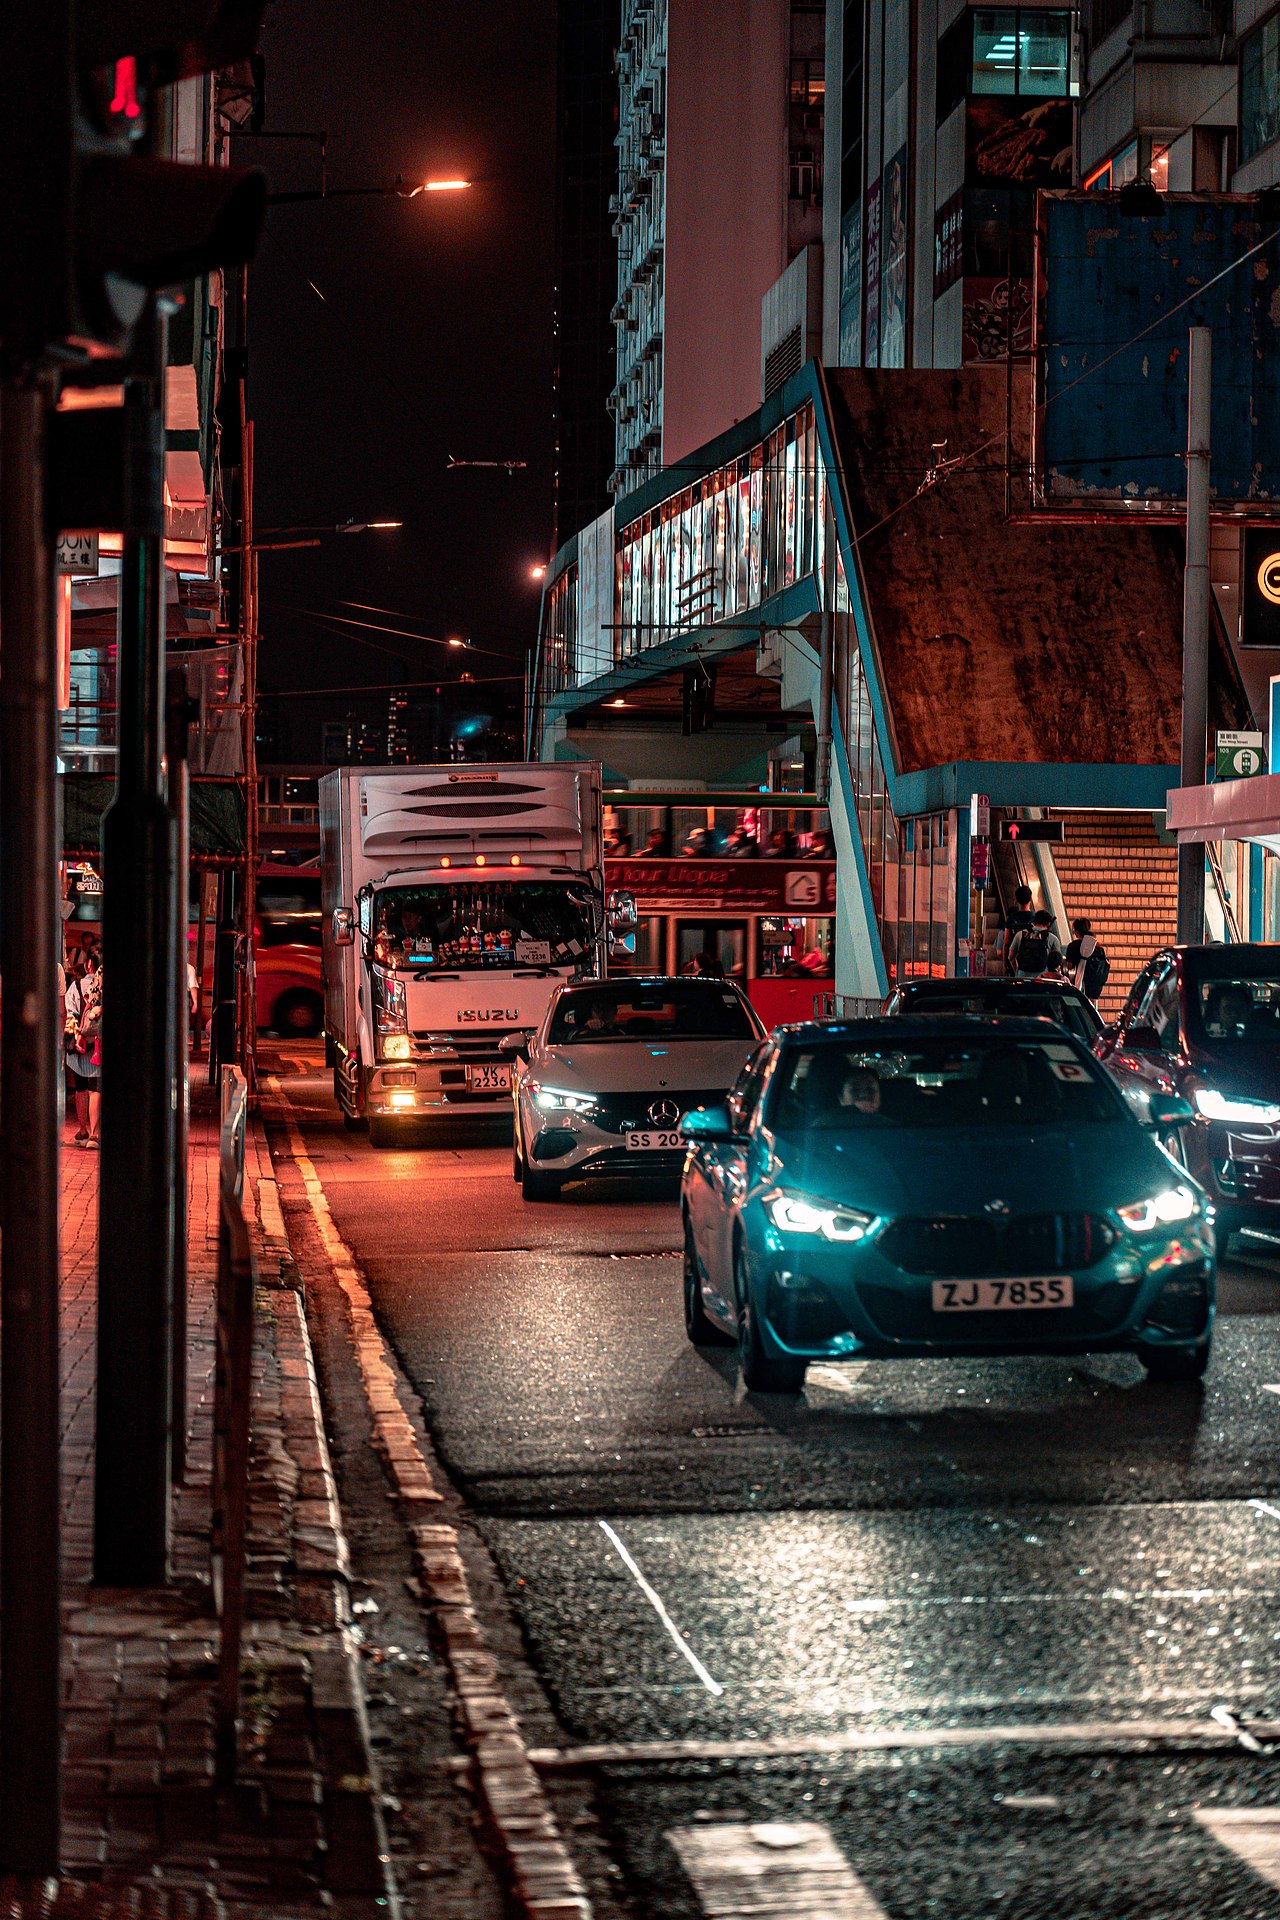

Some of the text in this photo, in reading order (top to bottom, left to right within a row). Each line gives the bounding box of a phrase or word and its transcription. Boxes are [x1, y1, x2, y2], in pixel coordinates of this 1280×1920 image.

[457, 1009, 519, 1022] ISUZU
[482, 1067, 498, 1077] VK
[1058, 1064, 1081, 1078] P
[474, 1077, 507, 1087] 2236
[630, 1134, 650, 1147] SS
[942, 1281, 1065, 1306] ZJ 7855
